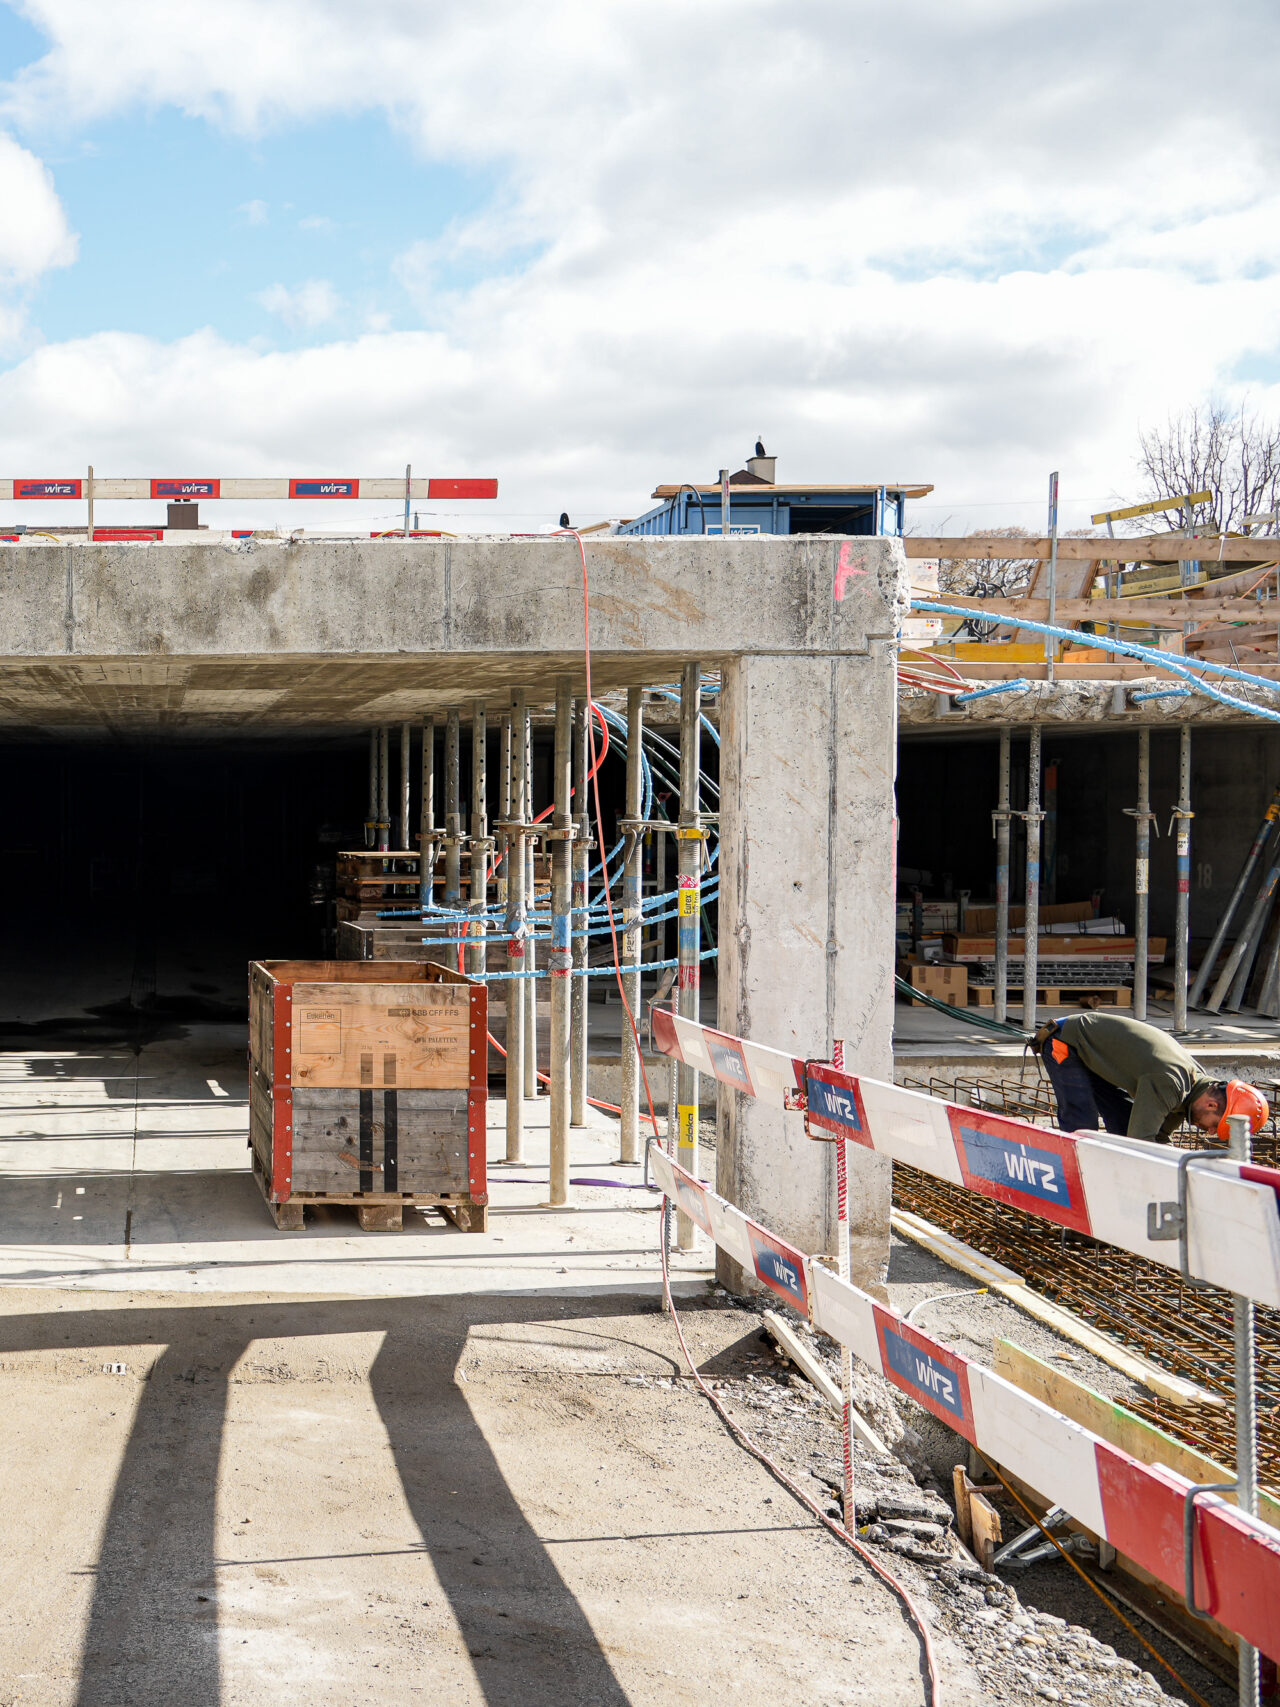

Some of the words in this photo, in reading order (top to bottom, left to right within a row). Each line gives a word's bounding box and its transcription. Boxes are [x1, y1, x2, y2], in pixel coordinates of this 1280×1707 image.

[44, 483, 71, 494] wirz
[181, 482, 208, 493] wirz
[320, 482, 347, 493] wirz
[1197, 863, 1212, 888] 18
[683, 894, 692, 914] Eurex
[306, 1012, 335, 1020] Etiketten
[412, 1009, 427, 1017] SBB
[428, 1009, 443, 1017] CFF
[444, 1009, 459, 1017] FFS
[724, 1048, 743, 1075] wirz
[824, 1084, 854, 1121] wirz
[686, 1112, 694, 1142] doka
[1003, 1143, 1059, 1193] wirz
[773, 1255, 798, 1291] wirz
[915, 1355, 955, 1405] wirz
